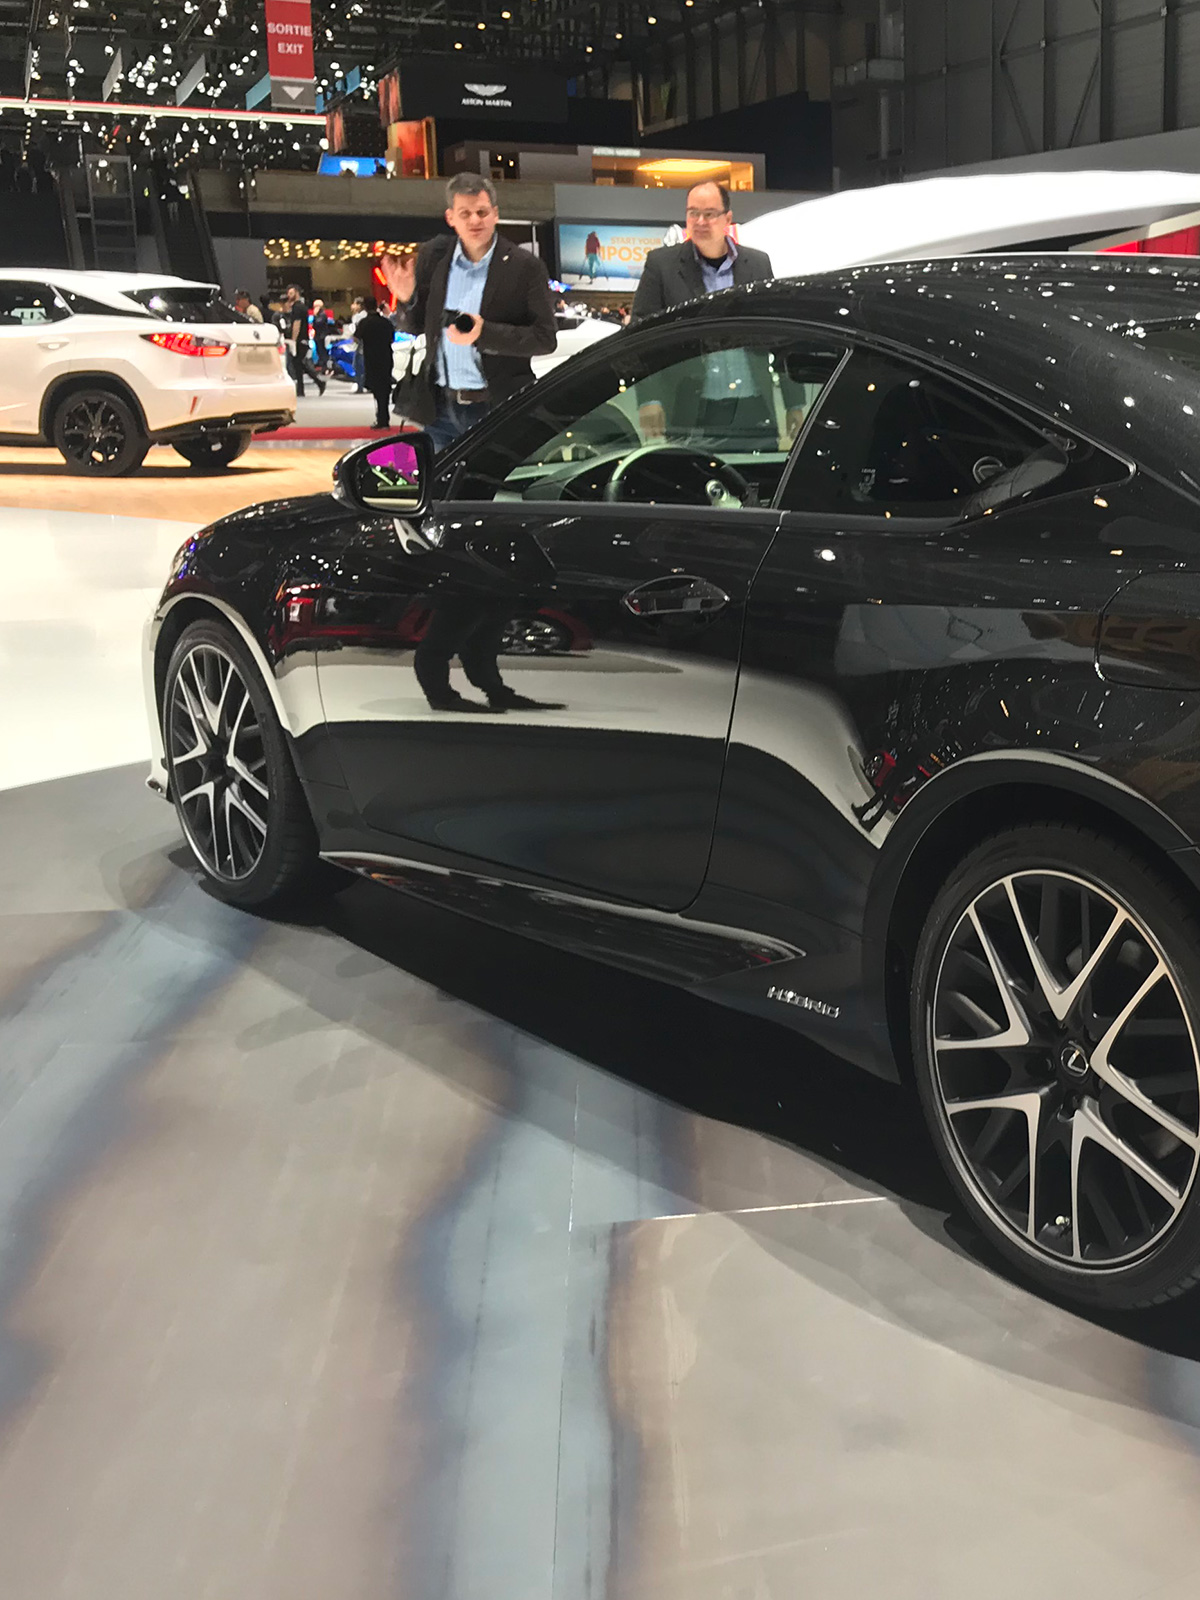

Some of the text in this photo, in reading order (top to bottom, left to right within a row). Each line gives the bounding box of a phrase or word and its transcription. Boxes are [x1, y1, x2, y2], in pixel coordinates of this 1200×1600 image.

[267, 22, 312, 37] SORTIE
[277, 42, 304, 55] EXIT
[610, 236, 661, 246] START YOUR
